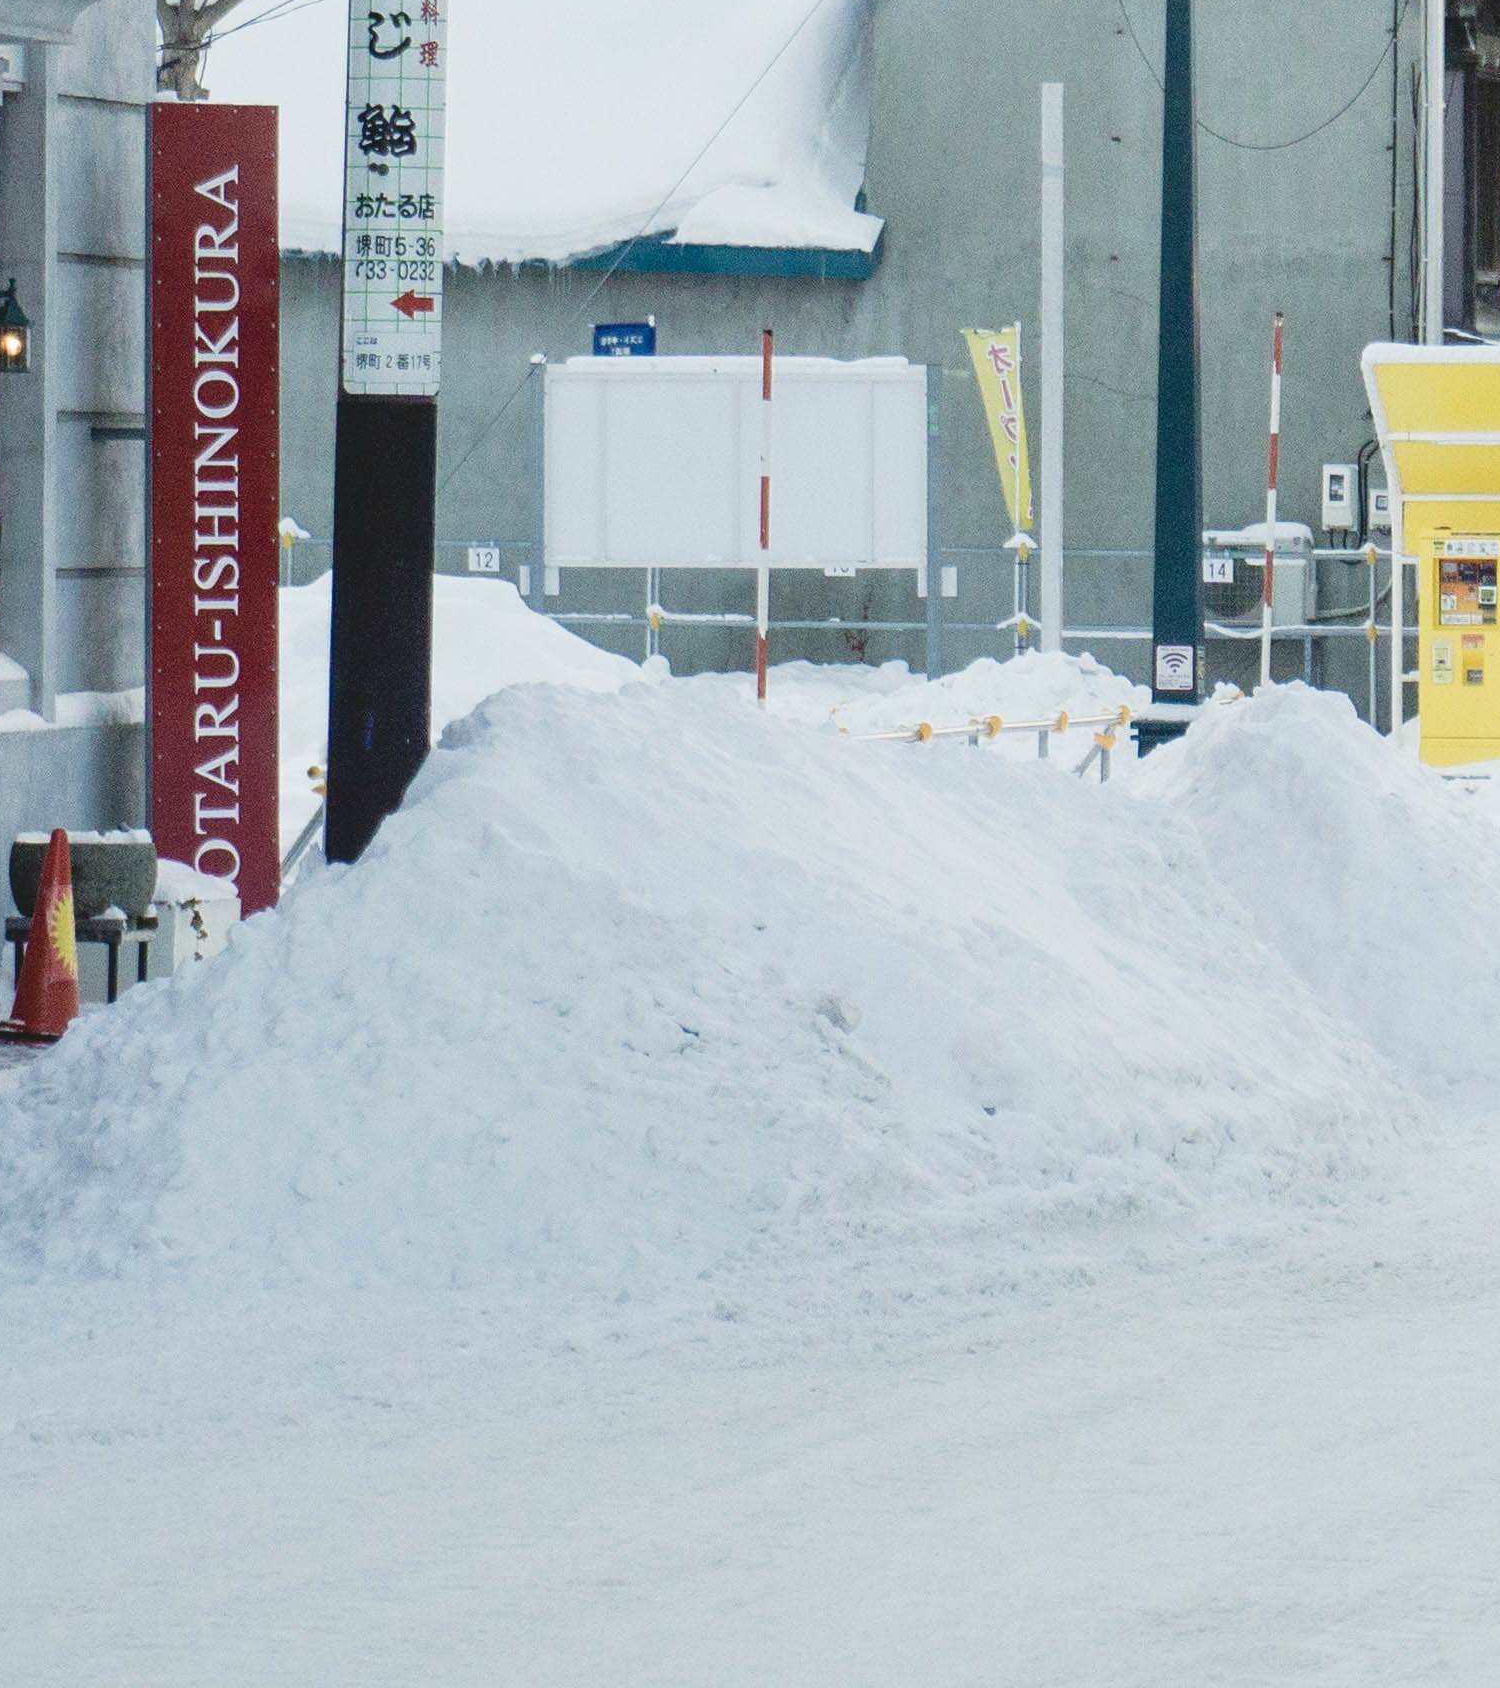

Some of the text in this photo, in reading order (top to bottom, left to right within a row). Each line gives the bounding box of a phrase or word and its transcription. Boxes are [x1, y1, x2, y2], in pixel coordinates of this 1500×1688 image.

[355, 192, 436, 220] おたる店
[193, 164, 241, 884] OTARU-ISHINOKURA
[1208, 562, 1227, 579] 14
